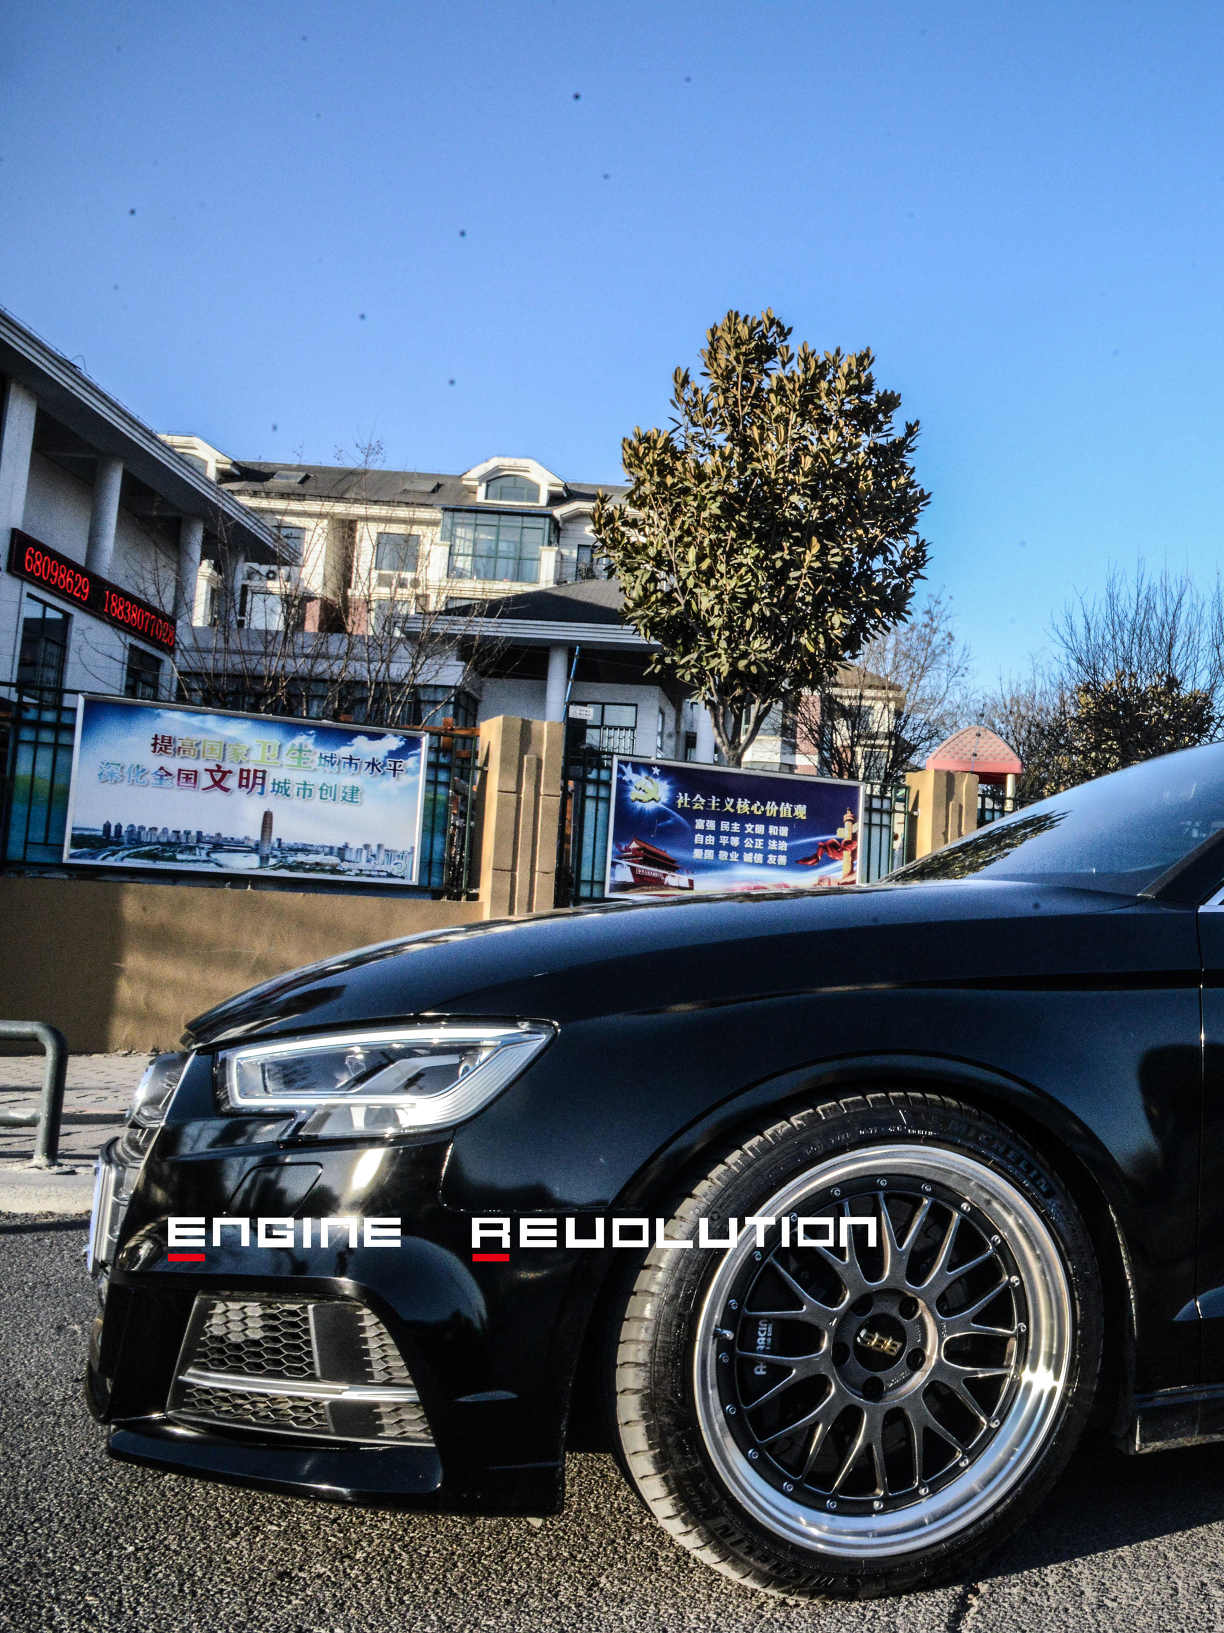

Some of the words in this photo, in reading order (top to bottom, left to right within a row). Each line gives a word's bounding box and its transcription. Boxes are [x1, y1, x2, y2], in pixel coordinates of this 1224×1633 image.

[25, 546, 90, 601] 68098629
[150, 733, 405, 779] 提高国家卫生城市水平
[97, 763, 362, 805] 深化全国文明城市创建
[676, 792, 807, 820] 社会主义核心价值观
[694, 834, 715, 846] 自由
[719, 835, 740, 848] 平等
[743, 838, 764, 849] 公正
[767, 840, 787, 852] 法治
[695, 818, 716, 831] 富强
[720, 821, 740, 833] 民主
[744, 823, 765, 835] 文明
[768, 825, 789, 837] 和谐
[756, 1319, 768, 1351] RACIN
